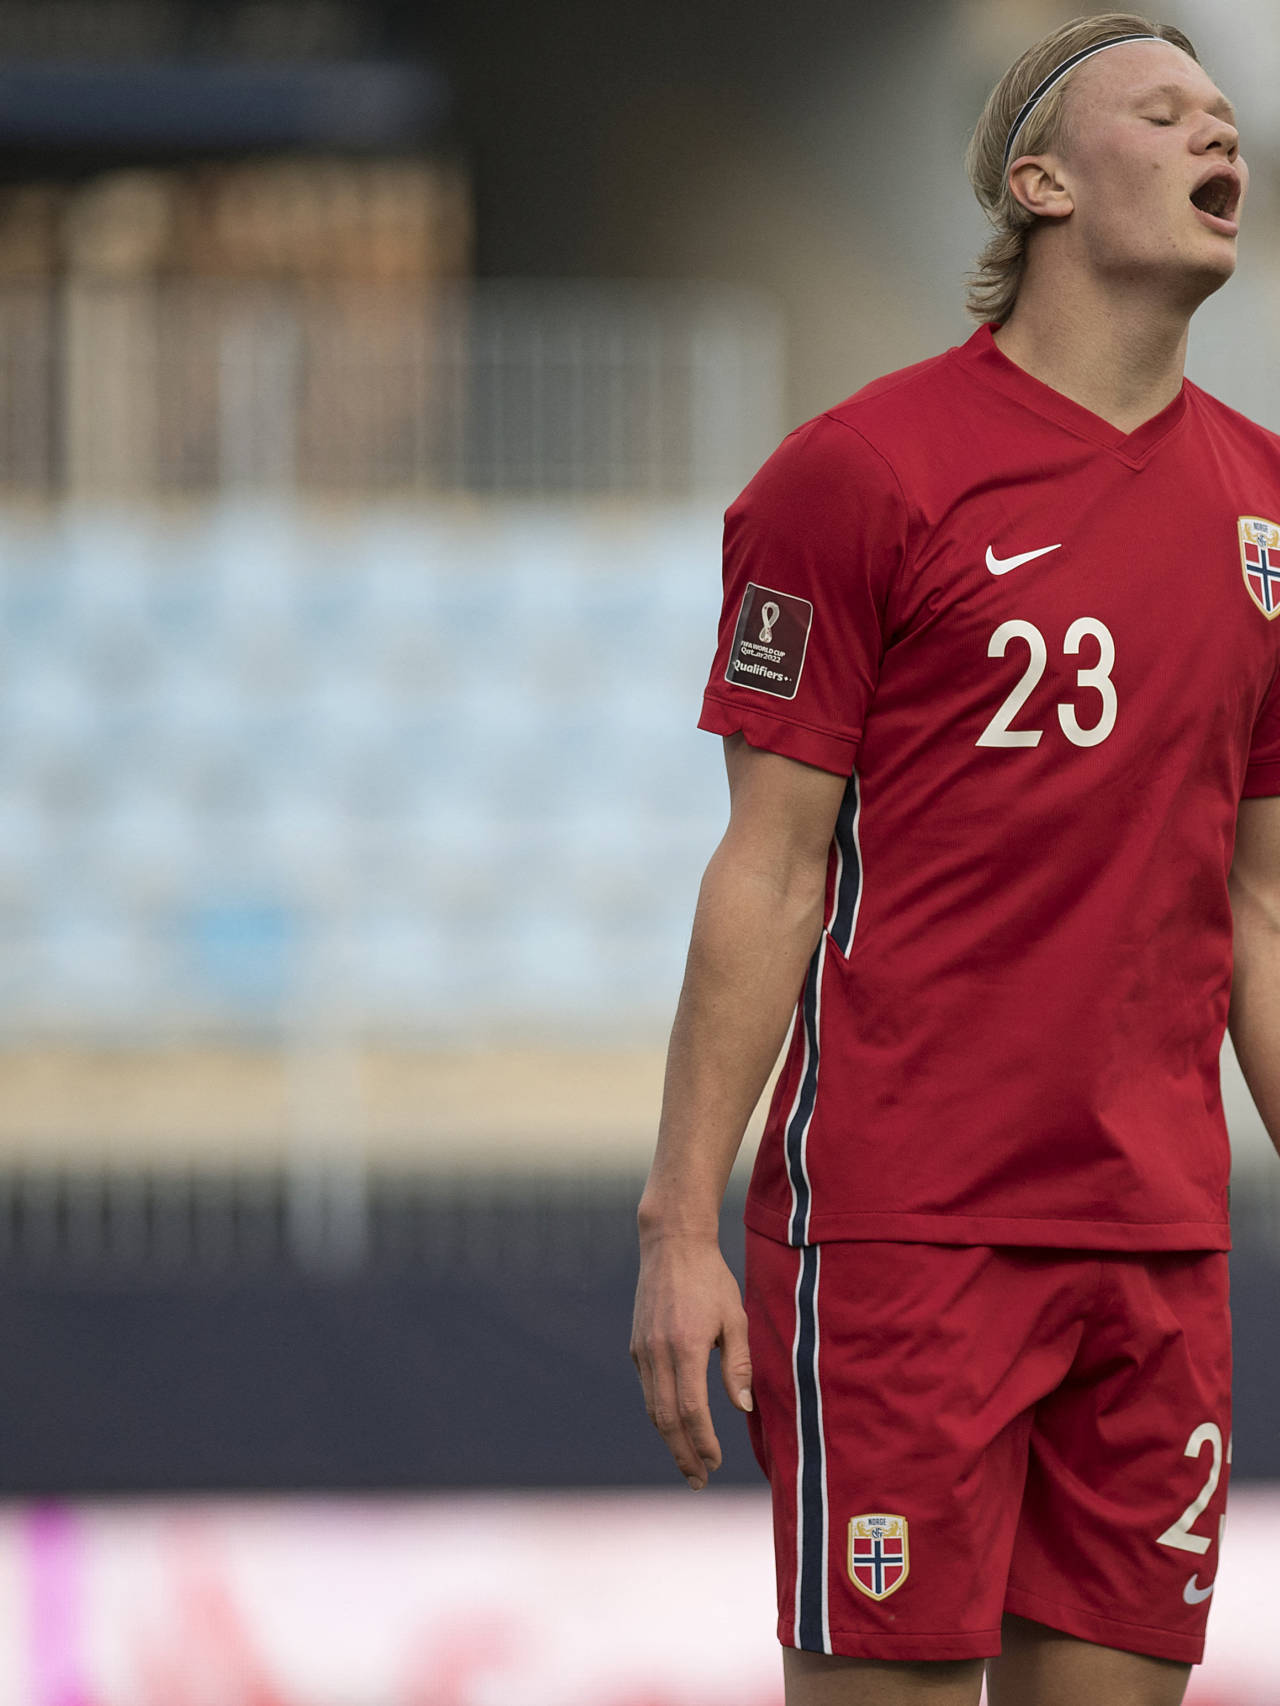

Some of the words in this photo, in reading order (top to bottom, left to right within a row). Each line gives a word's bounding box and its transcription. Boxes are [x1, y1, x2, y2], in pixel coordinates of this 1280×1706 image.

[733, 659, 783, 681] Qualifiers
[752, 643, 773, 653] WORLD
[773, 649, 785, 657] CUP
[975, 616, 1118, 748] 23
[1155, 1421, 1232, 1556] 2
